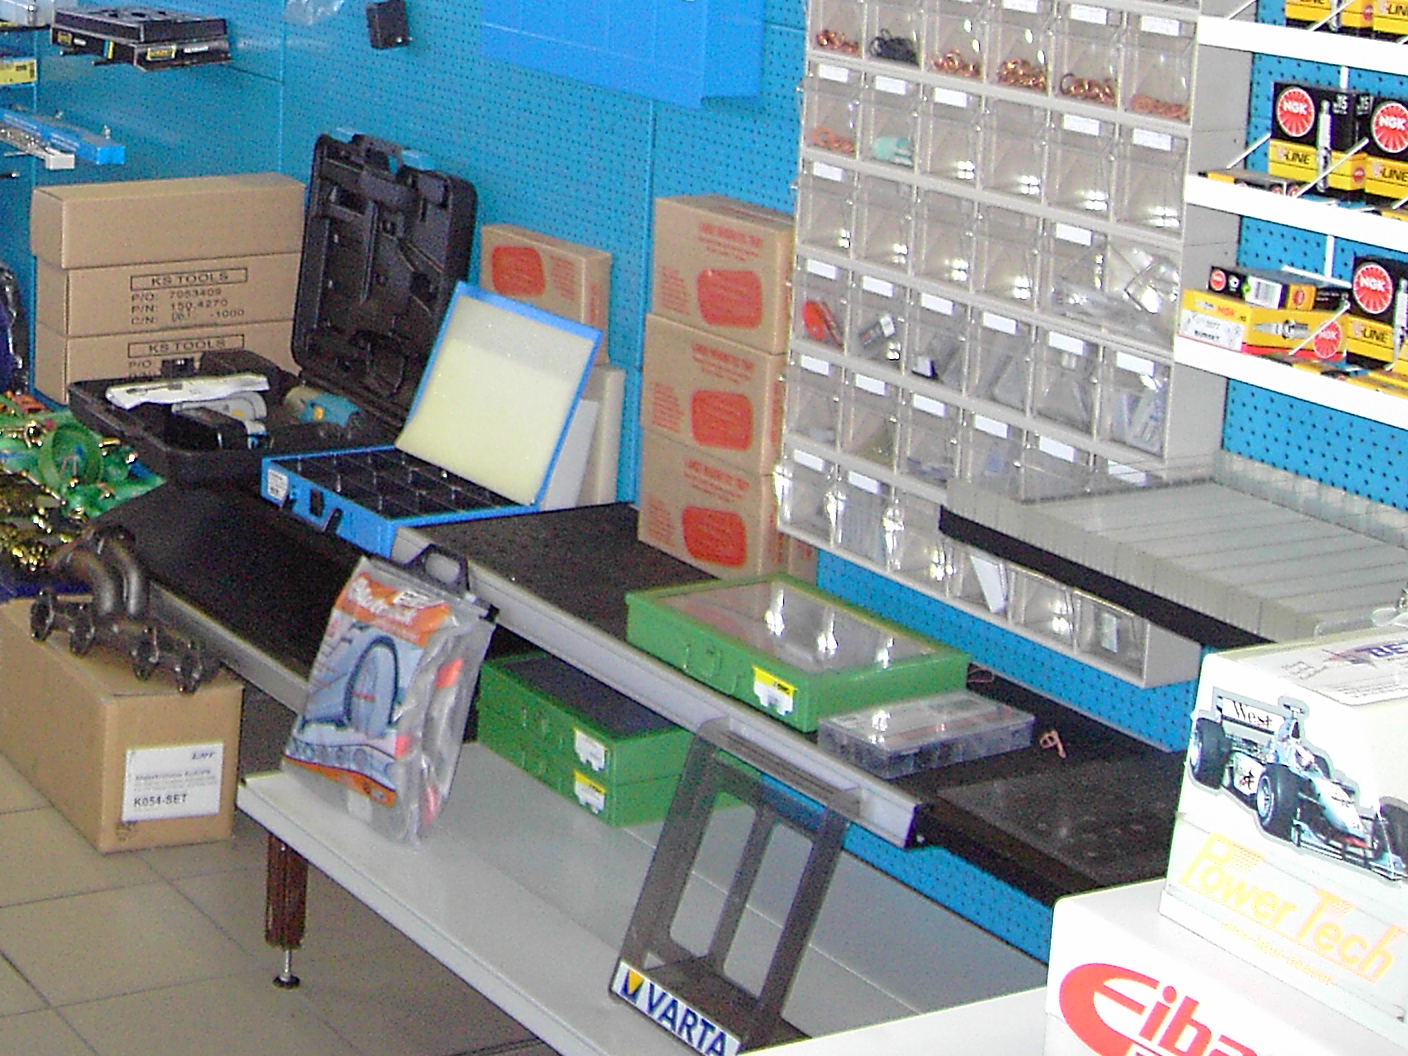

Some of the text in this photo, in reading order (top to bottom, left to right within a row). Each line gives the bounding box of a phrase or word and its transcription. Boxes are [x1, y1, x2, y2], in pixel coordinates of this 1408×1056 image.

[1283, 100, 1308, 115] NGK
[1379, 115, 1407, 130] NGK
[152, 272, 228, 286] KS TOOLS
[1359, 275, 1386, 291] NGK
[149, 339, 225, 353] KS TOOLS
[1179, 832, 1298, 927] Power
[1297, 887, 1407, 980] Tech
[636, 983, 729, 1056] VARTA
